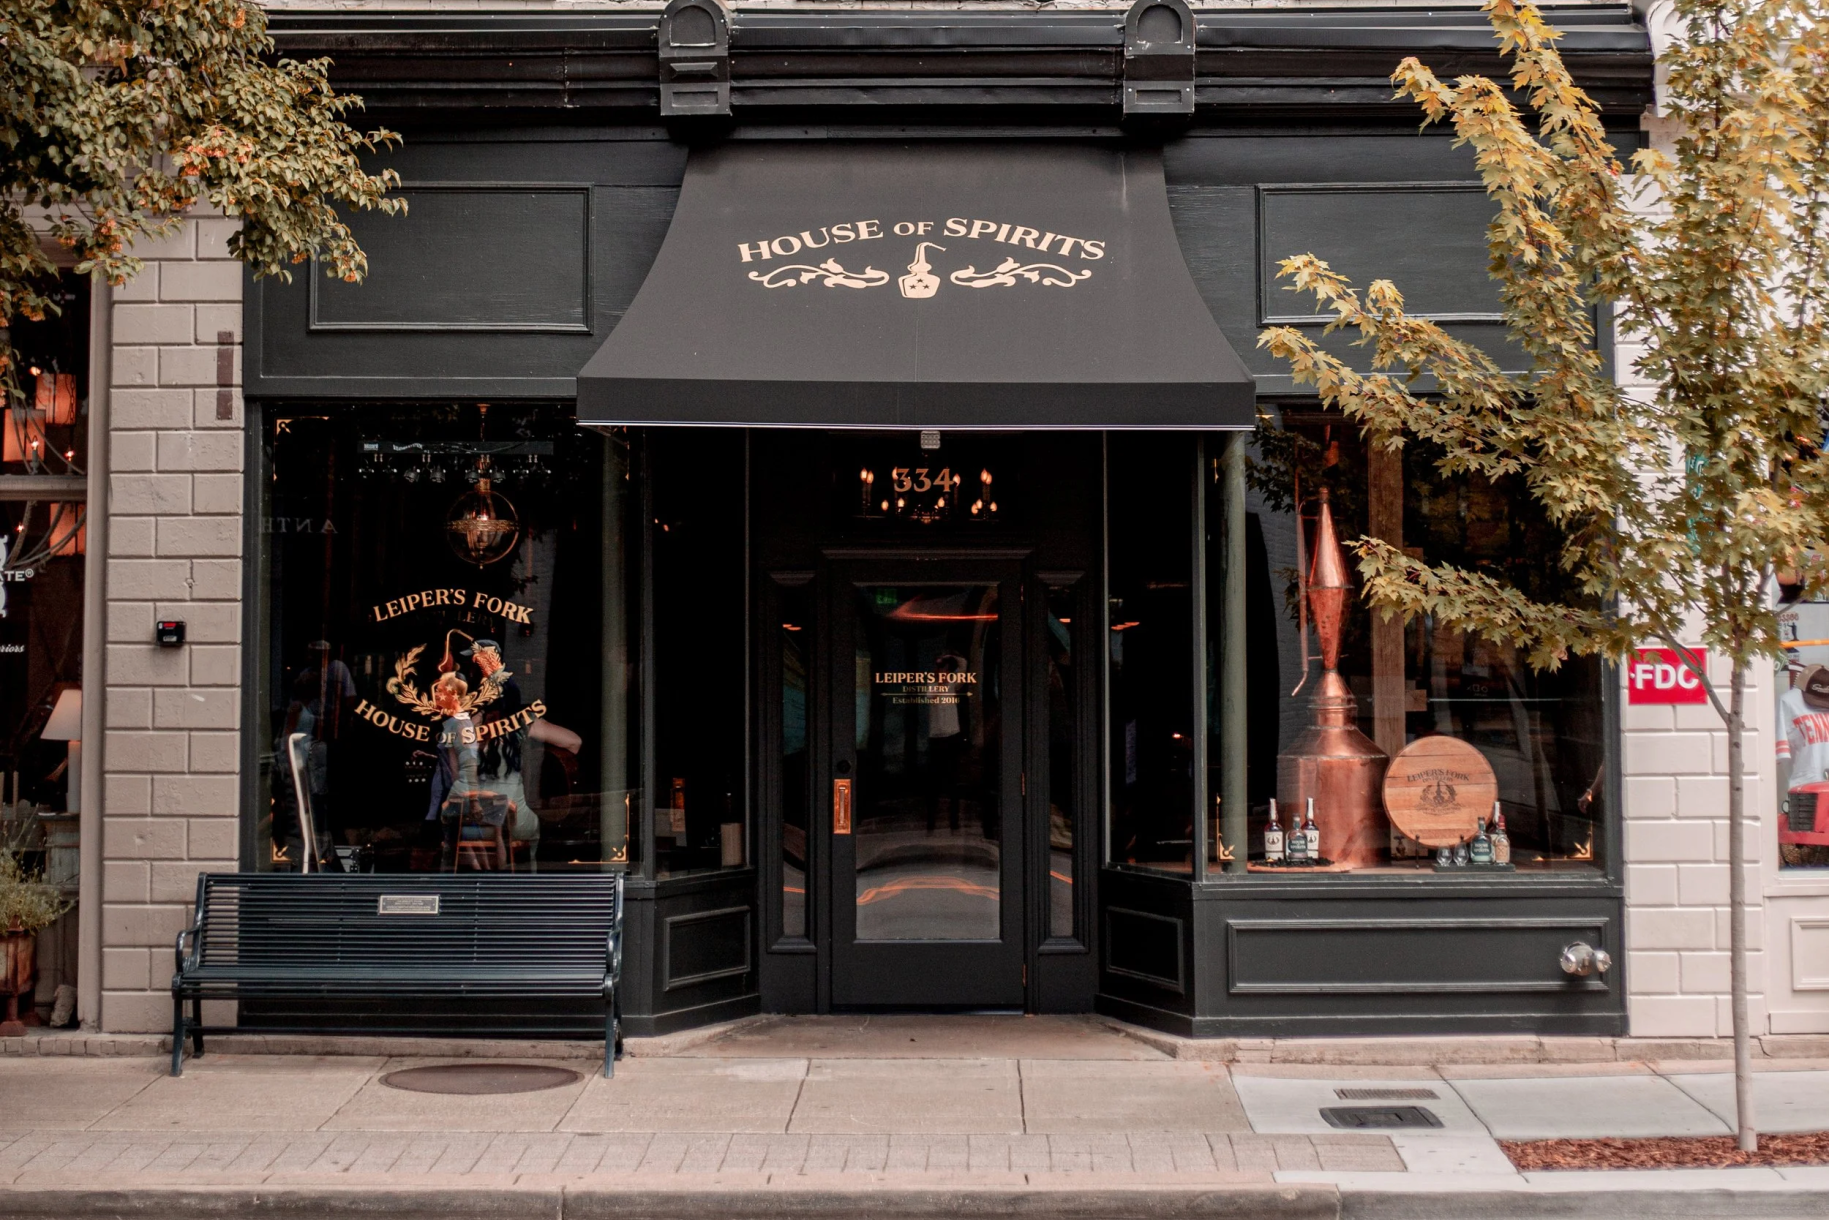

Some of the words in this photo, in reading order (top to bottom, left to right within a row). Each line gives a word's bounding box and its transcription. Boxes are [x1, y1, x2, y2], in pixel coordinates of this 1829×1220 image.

[737, 219, 884, 263] HOUSE
[893, 220, 934, 237] OF
[943, 217, 1106, 261] SPIRITS
[894, 468, 954, 492] 334
[0, 568, 34, 581] TE®
[373, 589, 467, 622] LEIPER'S
[473, 592, 534, 624] FORK
[875, 671, 936, 684] LEIPER'S
[938, 672, 977, 684] FORK
[1635, 663, 1699, 690] FDC
[902, 685, 950, 693] DISTILLERY
[892, 696, 940, 704] Established
[354, 699, 430, 742] HOUSE
[436, 731, 456, 745] OF
[461, 699, 547, 744] SPIRITS
[1446, 769, 1469, 781] FORK
